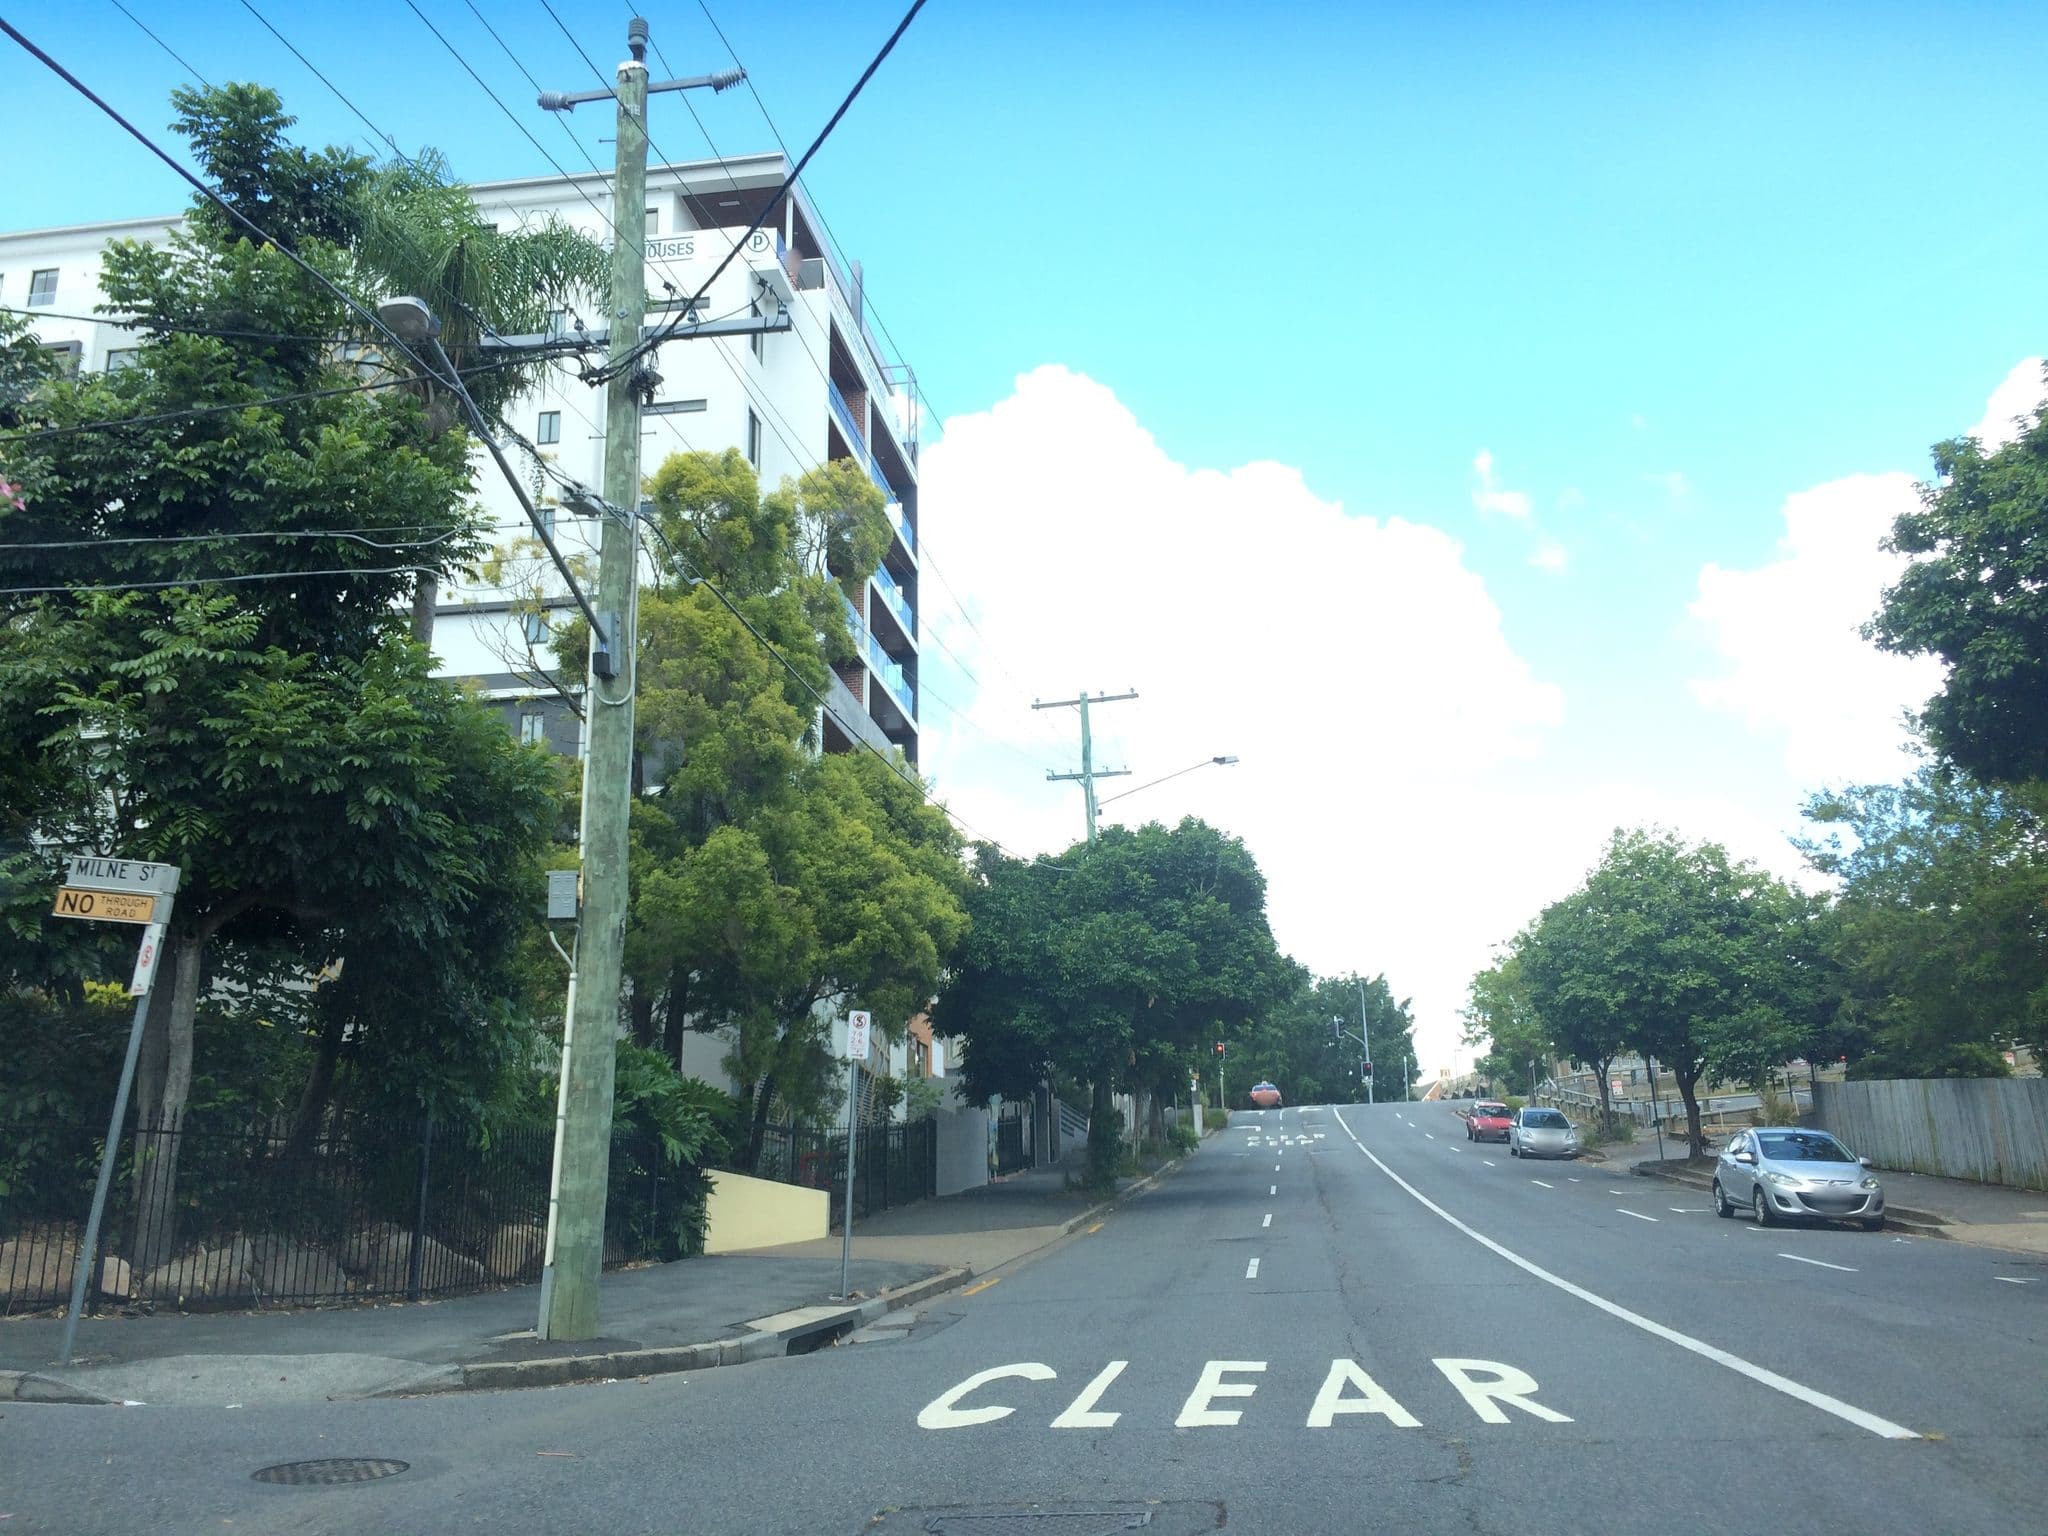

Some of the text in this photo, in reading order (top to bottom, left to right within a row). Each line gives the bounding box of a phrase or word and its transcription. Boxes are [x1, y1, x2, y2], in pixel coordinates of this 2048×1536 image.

[643, 241, 694, 260] OUSES
[75, 860, 158, 882] MILNE ST
[61, 893, 94, 914] NO
[100, 895, 148, 908] THROUGH
[105, 907, 137, 918] ROAD
[917, 1358, 1575, 1430] CLEAR
